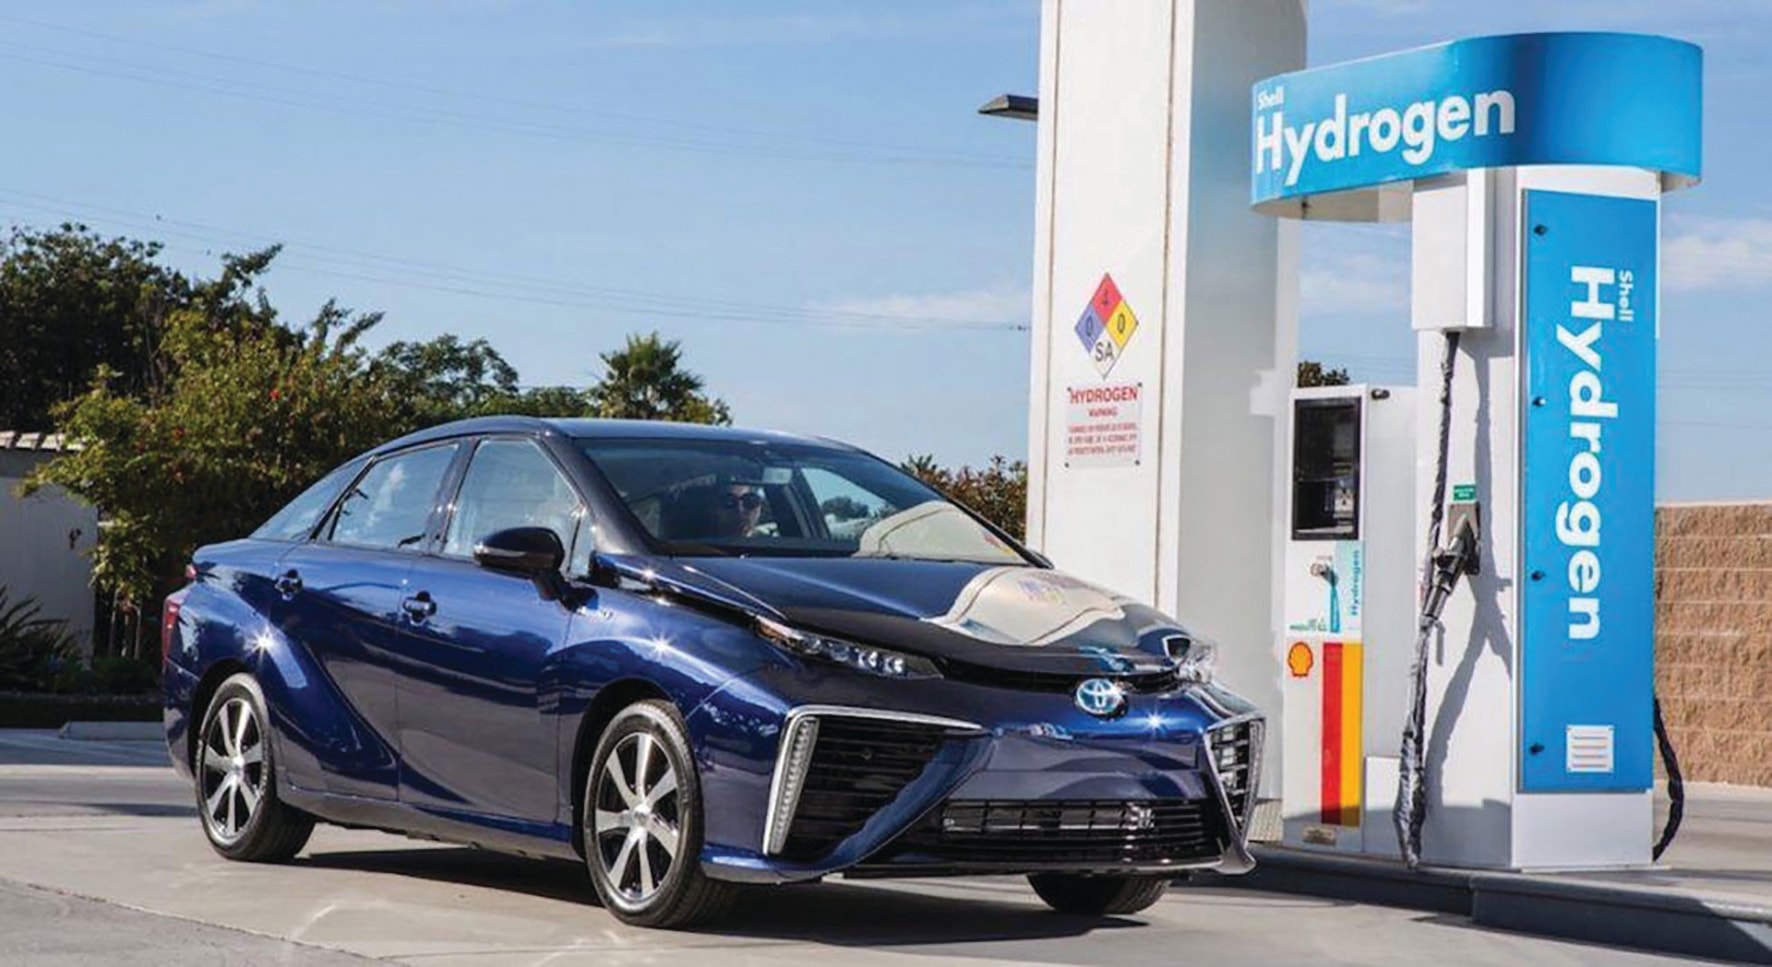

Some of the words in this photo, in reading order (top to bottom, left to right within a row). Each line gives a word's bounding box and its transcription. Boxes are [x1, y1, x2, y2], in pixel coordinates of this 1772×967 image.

[1258, 86, 1284, 110] Shell
[1255, 90, 1515, 185] Hydrogen
[1619, 269, 1635, 321] Shell
[1086, 315, 1094, 337] 0
[1117, 313, 1126, 334] 0
[1095, 341, 1115, 362] SA
[1070, 386, 1137, 404] HYDROGEN
[1556, 266, 1618, 640] Hydrogen
[1351, 550, 1361, 616] Hydrogen
